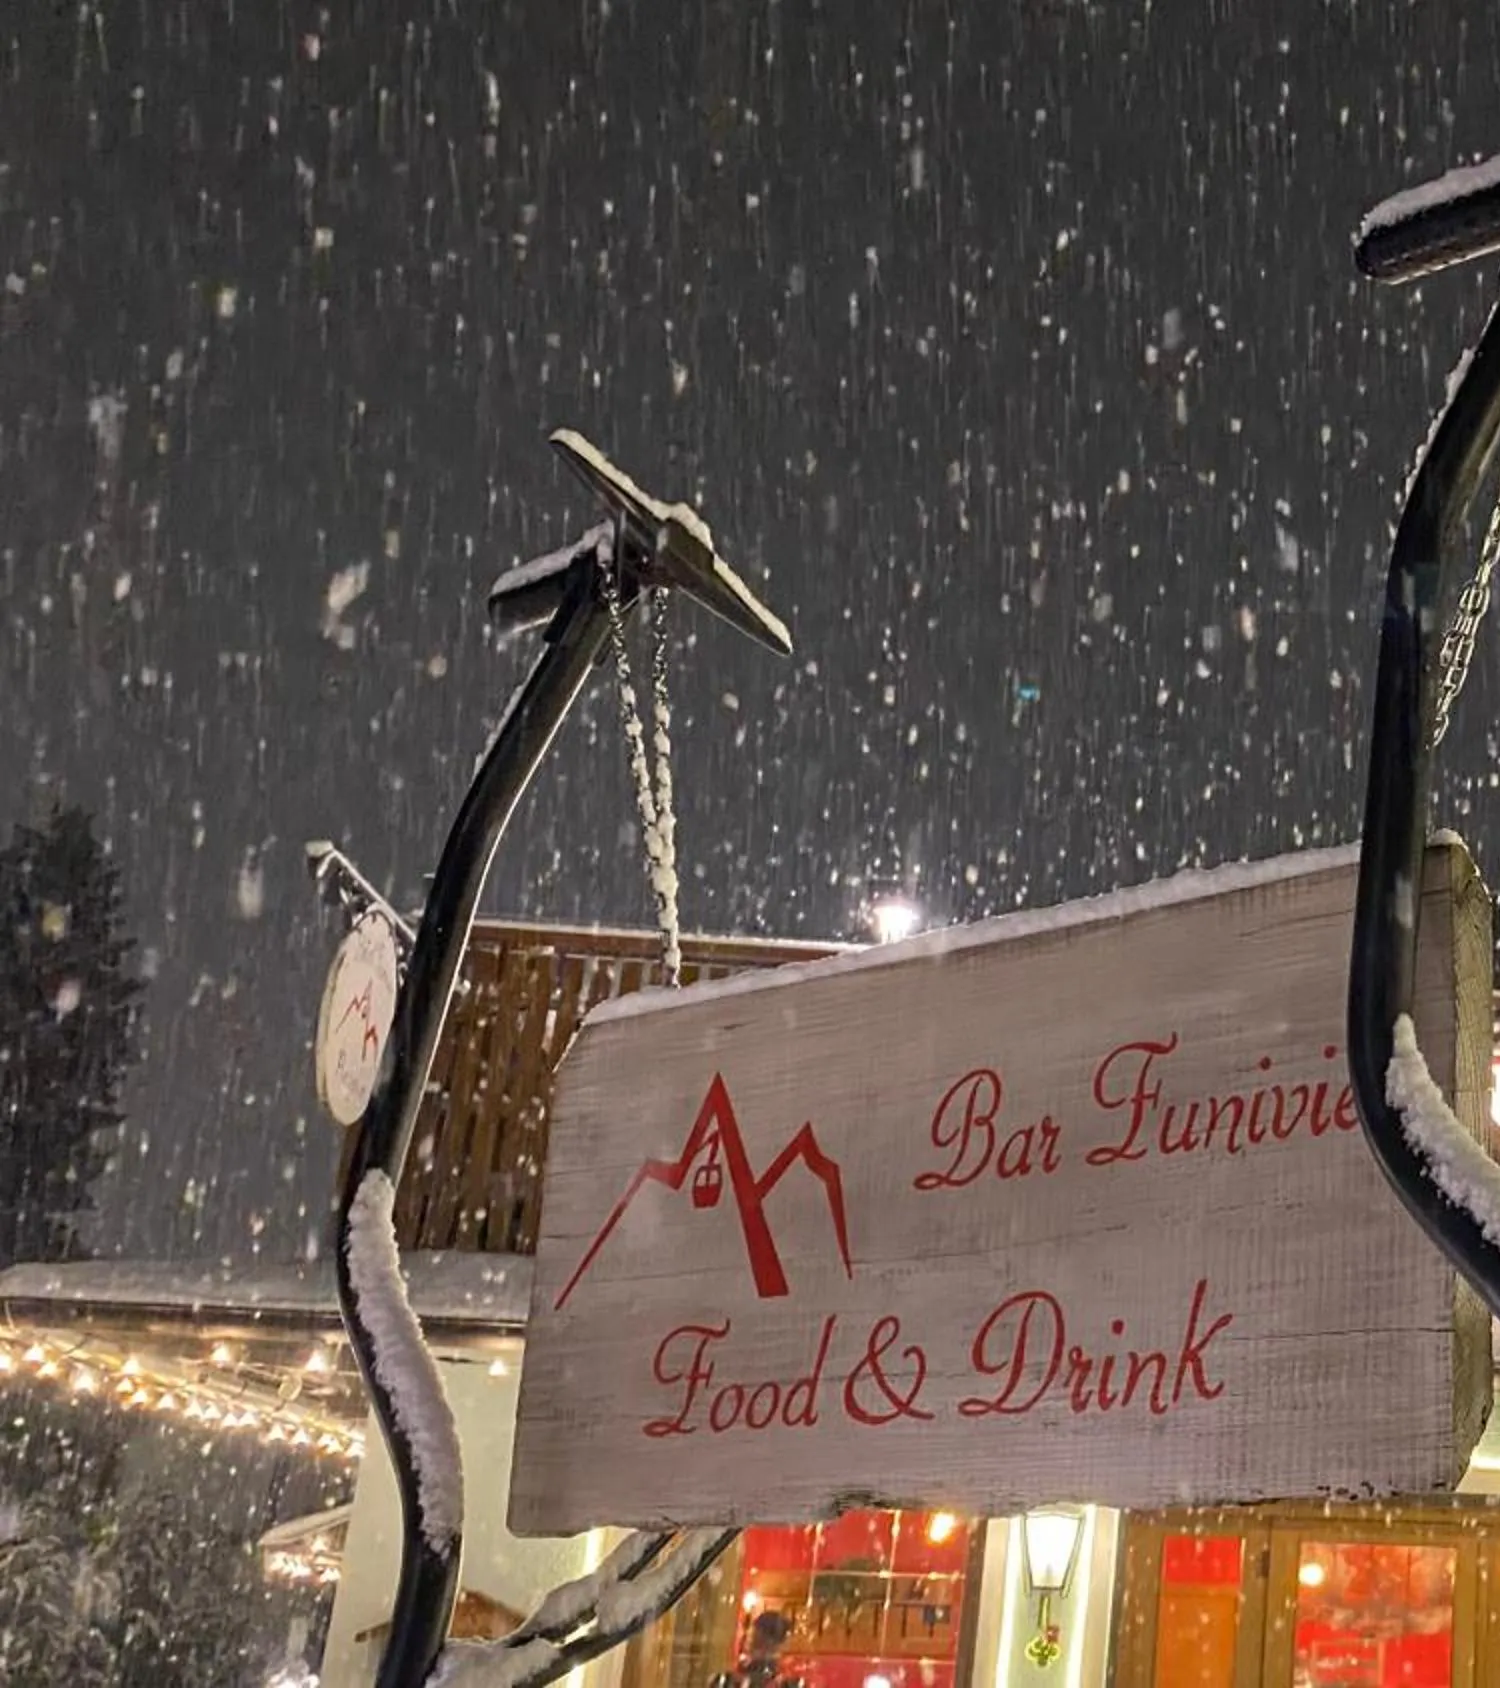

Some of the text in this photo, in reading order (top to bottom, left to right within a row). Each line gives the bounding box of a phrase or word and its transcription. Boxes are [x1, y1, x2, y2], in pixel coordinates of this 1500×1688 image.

[913, 1032, 1360, 1190] Bar Funivie
[643, 1279, 1233, 1437] Food & Drink
